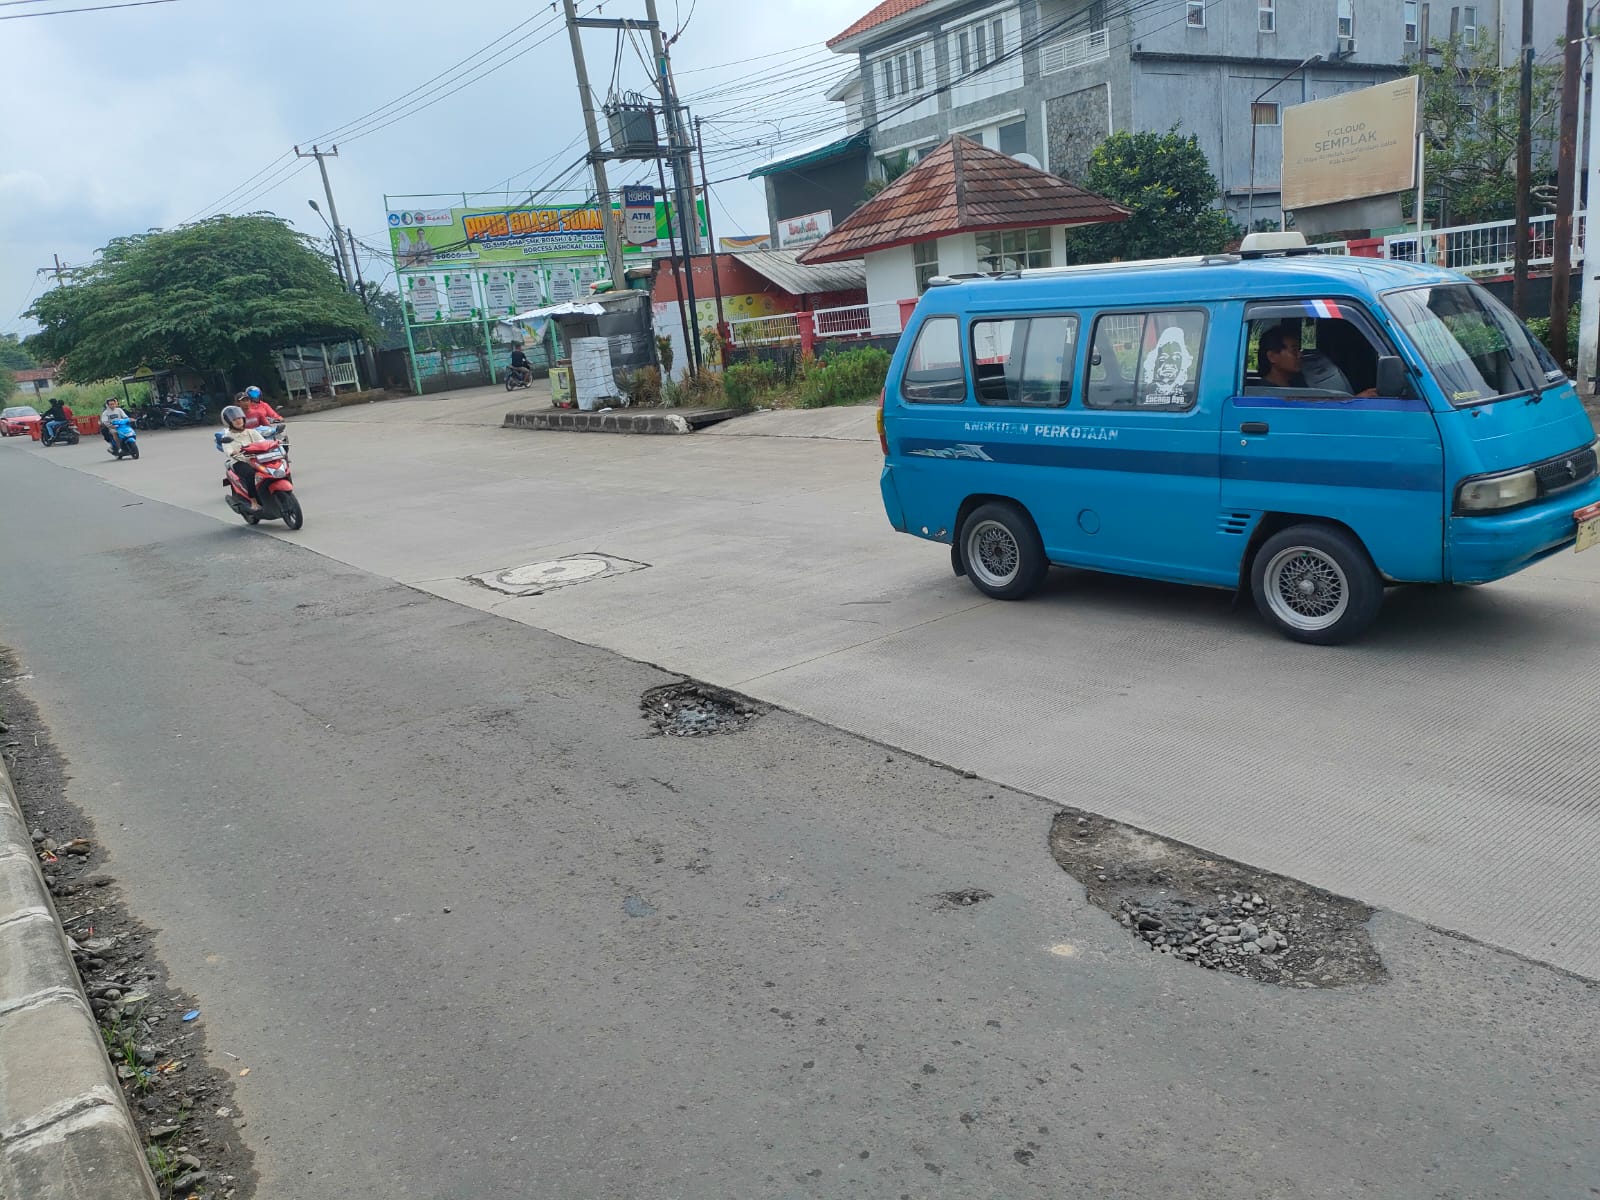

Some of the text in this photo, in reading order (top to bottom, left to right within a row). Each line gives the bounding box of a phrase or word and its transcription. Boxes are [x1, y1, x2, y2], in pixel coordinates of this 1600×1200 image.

[1314, 130, 1377, 153] SEMPLAK
[464, 213, 509, 239] PPDB
[509, 209, 561, 235] BOASH
[631, 212, 651, 220] ATM
[1035, 425, 1119, 441] PERKOTAAN
